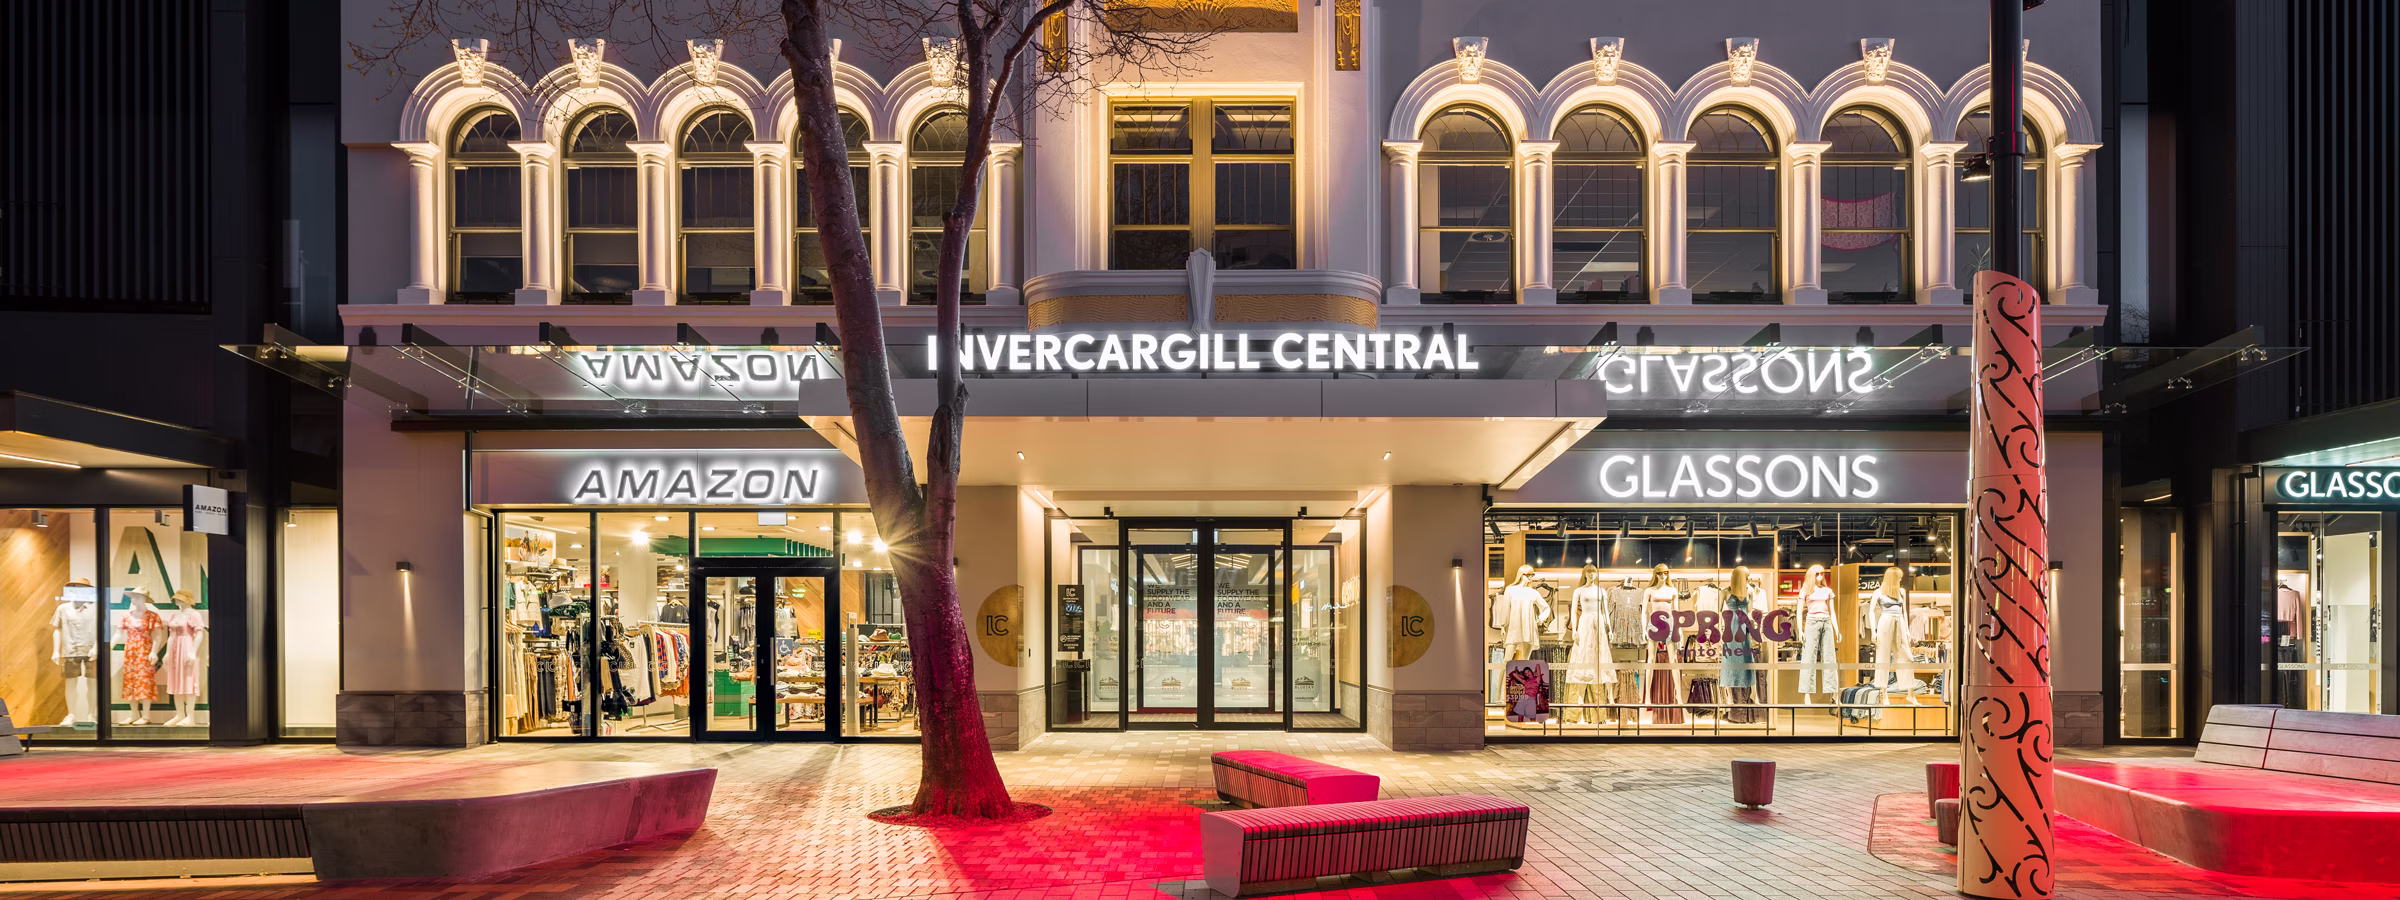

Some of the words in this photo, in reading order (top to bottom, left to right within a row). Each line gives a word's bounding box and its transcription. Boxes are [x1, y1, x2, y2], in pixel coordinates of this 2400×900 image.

[1273, 332, 1479, 370] CENTRAL
[574, 469, 819, 499] AMAZON
[1600, 454, 1879, 498] GLASSONS
[2285, 471, 2400, 498] GLASSO
[195, 504, 227, 514] AMAZON
[1648, 610, 1792, 644] SPRING
